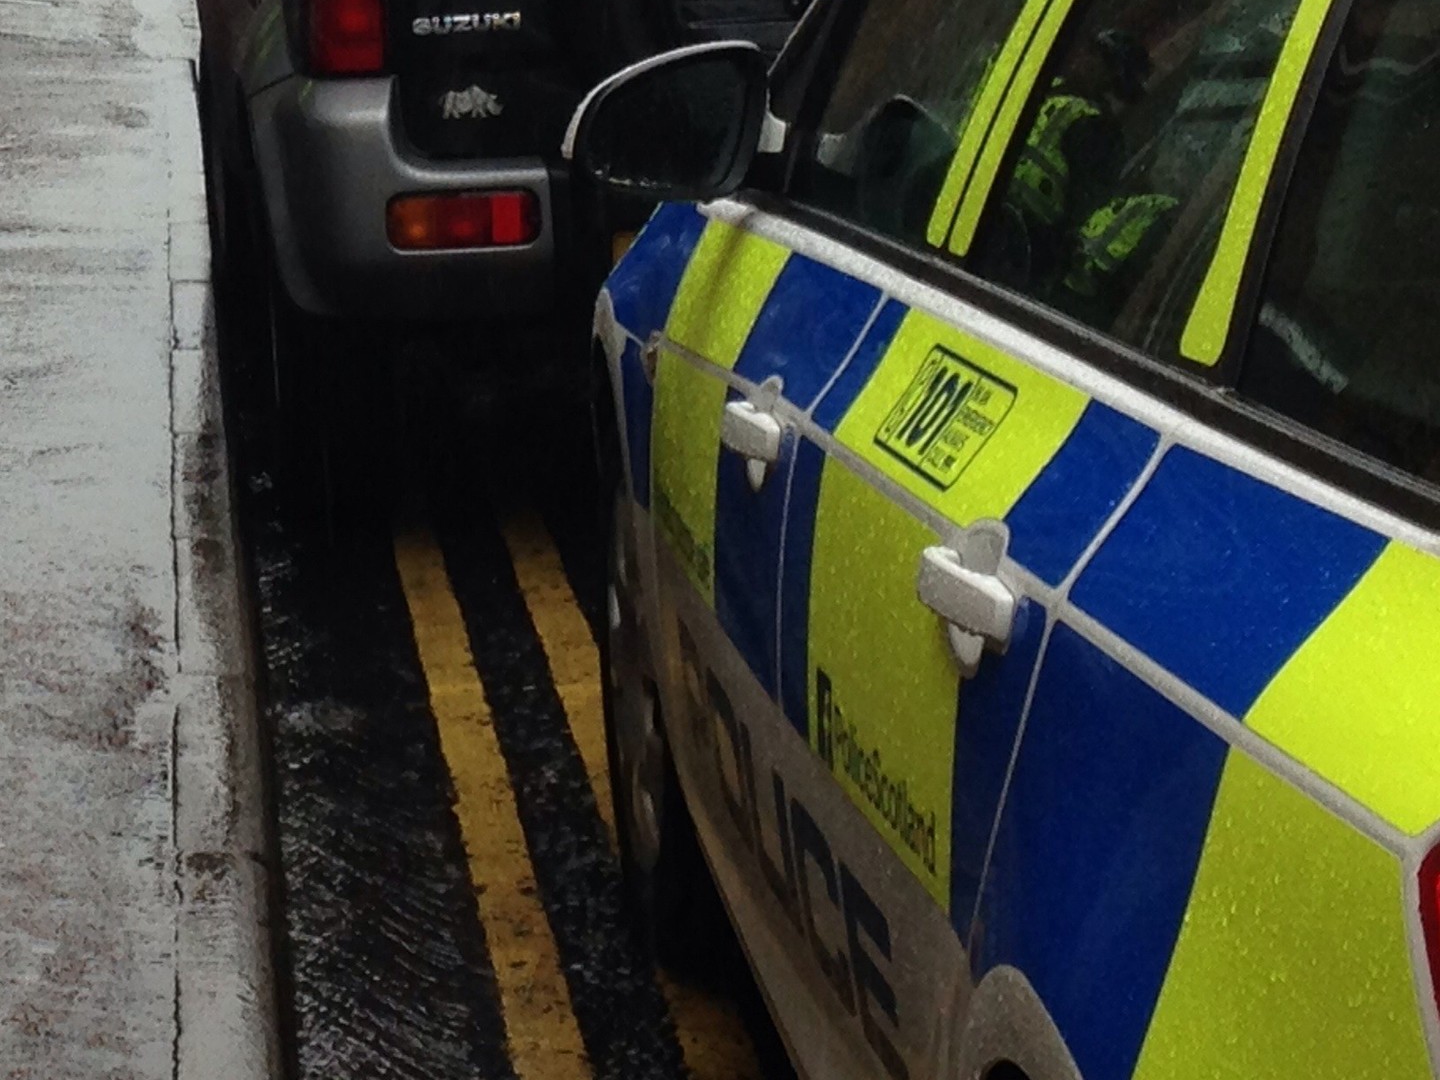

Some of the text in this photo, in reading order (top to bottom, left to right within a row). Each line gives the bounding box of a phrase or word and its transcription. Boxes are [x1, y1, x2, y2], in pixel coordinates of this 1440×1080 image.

[412, 10, 521, 36] SUZUKI
[896, 366, 974, 456] 101
[677, 611, 910, 1080] POLICE
